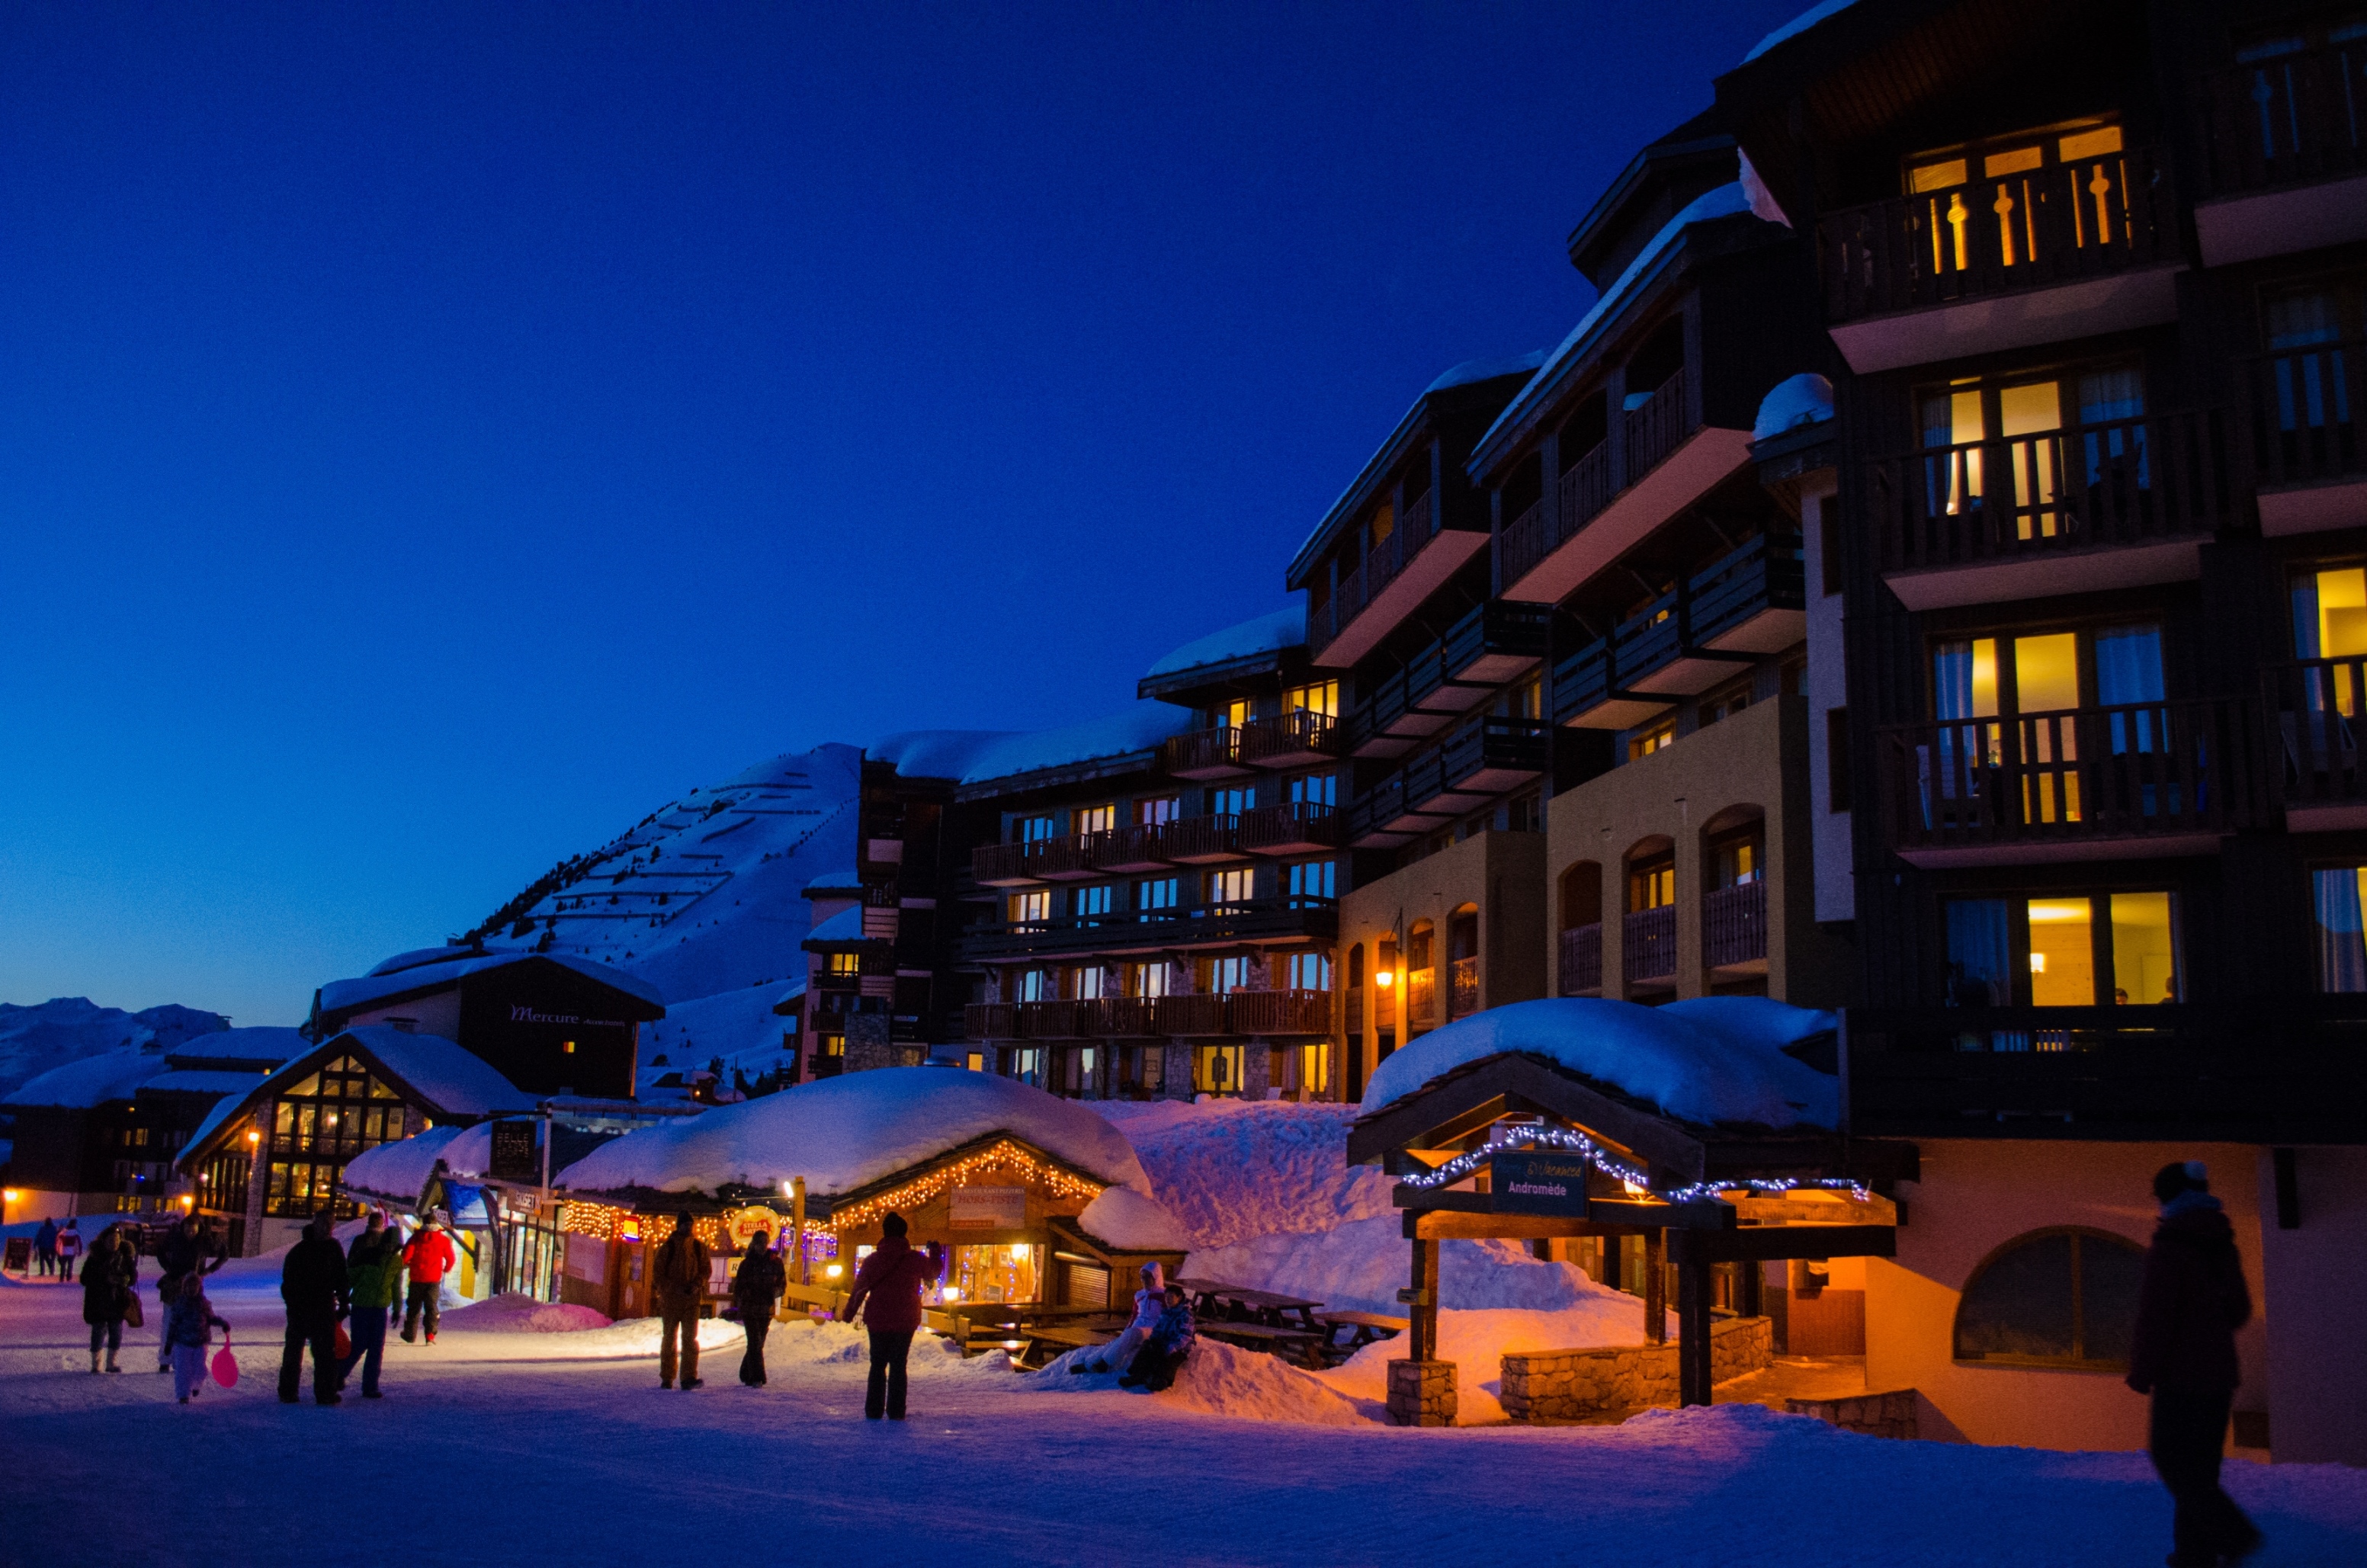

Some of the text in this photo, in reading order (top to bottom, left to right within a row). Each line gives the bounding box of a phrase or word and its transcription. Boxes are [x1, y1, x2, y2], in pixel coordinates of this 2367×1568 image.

[511, 1003, 579, 1024] Mercure
[497, 1133, 529, 1143] BELLE
[1508, 1181, 1567, 1196] Andromède
